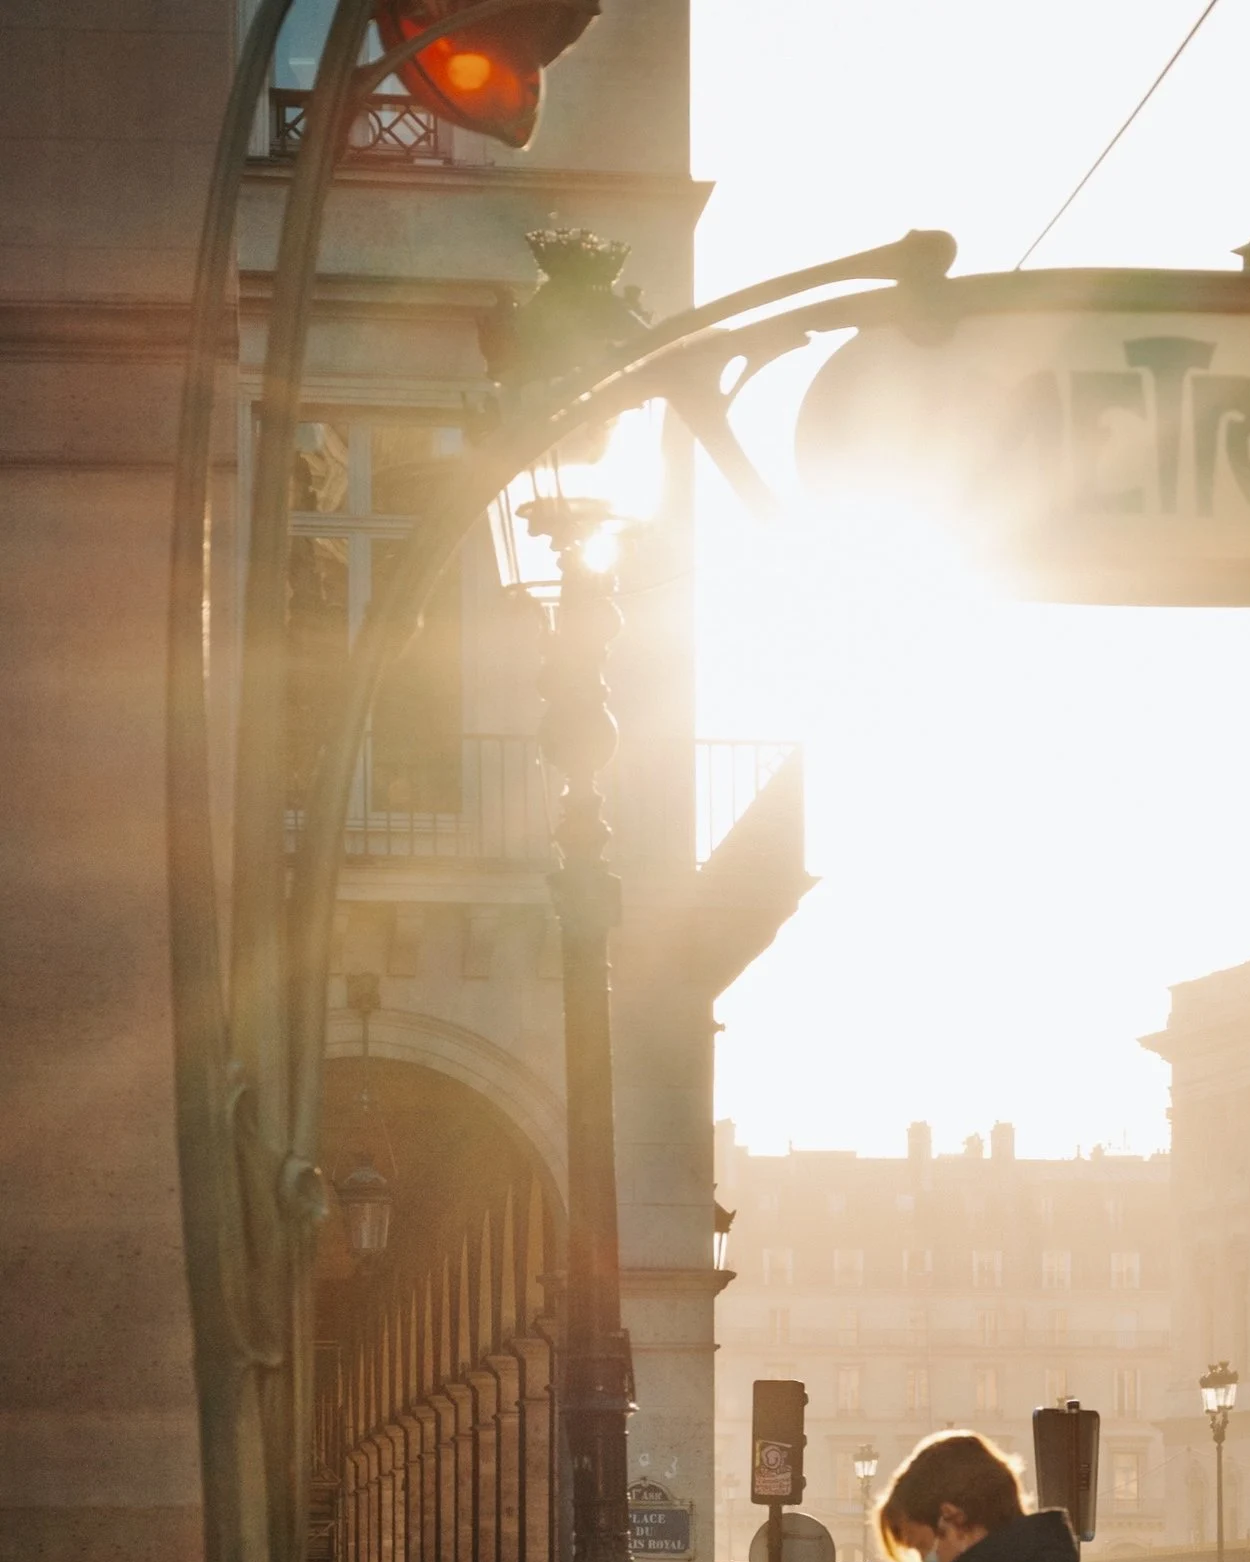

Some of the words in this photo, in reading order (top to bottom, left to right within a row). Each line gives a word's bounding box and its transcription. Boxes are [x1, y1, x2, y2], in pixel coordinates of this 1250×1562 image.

[628, 1513, 666, 1524] LACE
[636, 1526, 652, 1536] DU
[647, 1539, 685, 1550] ROYAL
